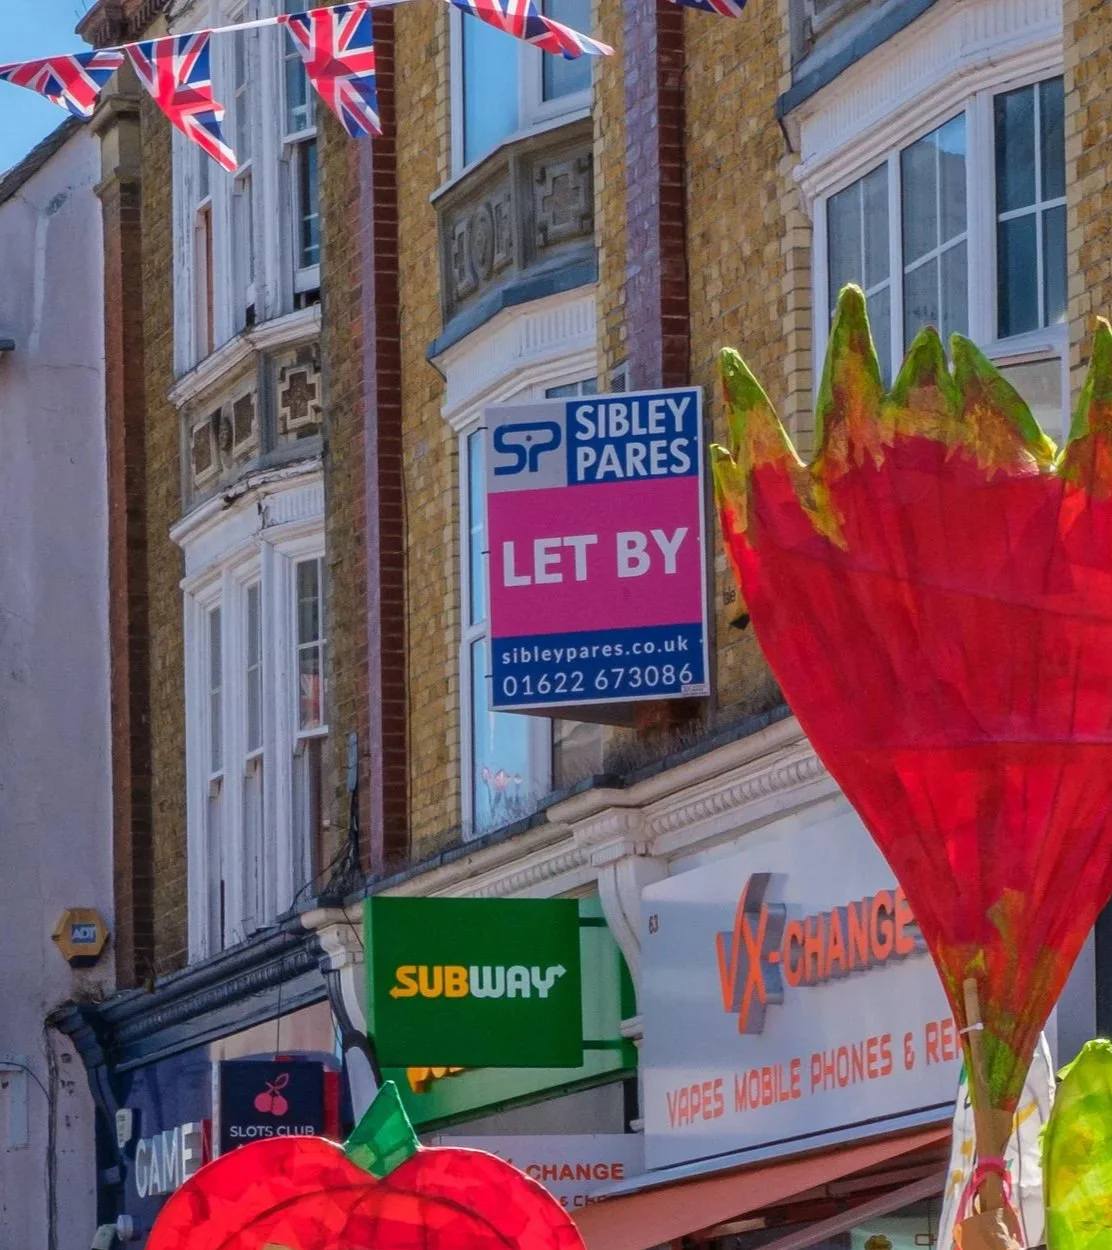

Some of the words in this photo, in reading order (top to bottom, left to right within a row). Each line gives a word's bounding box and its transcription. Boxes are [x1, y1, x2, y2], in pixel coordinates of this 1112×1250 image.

[575, 396, 691, 441] SIBLEY
[576, 438, 690, 481] PARES
[503, 534, 597, 587] LET
[616, 527, 688, 578] BY
[501, 635, 688, 665] sibleypares.co.uk
[503, 671, 584, 697] 01622
[594, 663, 693, 690] 673086
[389, 964, 567, 999] SUBWAY
[667, 1078, 724, 1128] VAPES
[734, 1058, 800, 1112] MOBILE
[811, 1033, 892, 1094] PHONES
[230, 1126, 273, 1137] SLOTS
[277, 1125, 314, 1136] CLUB
